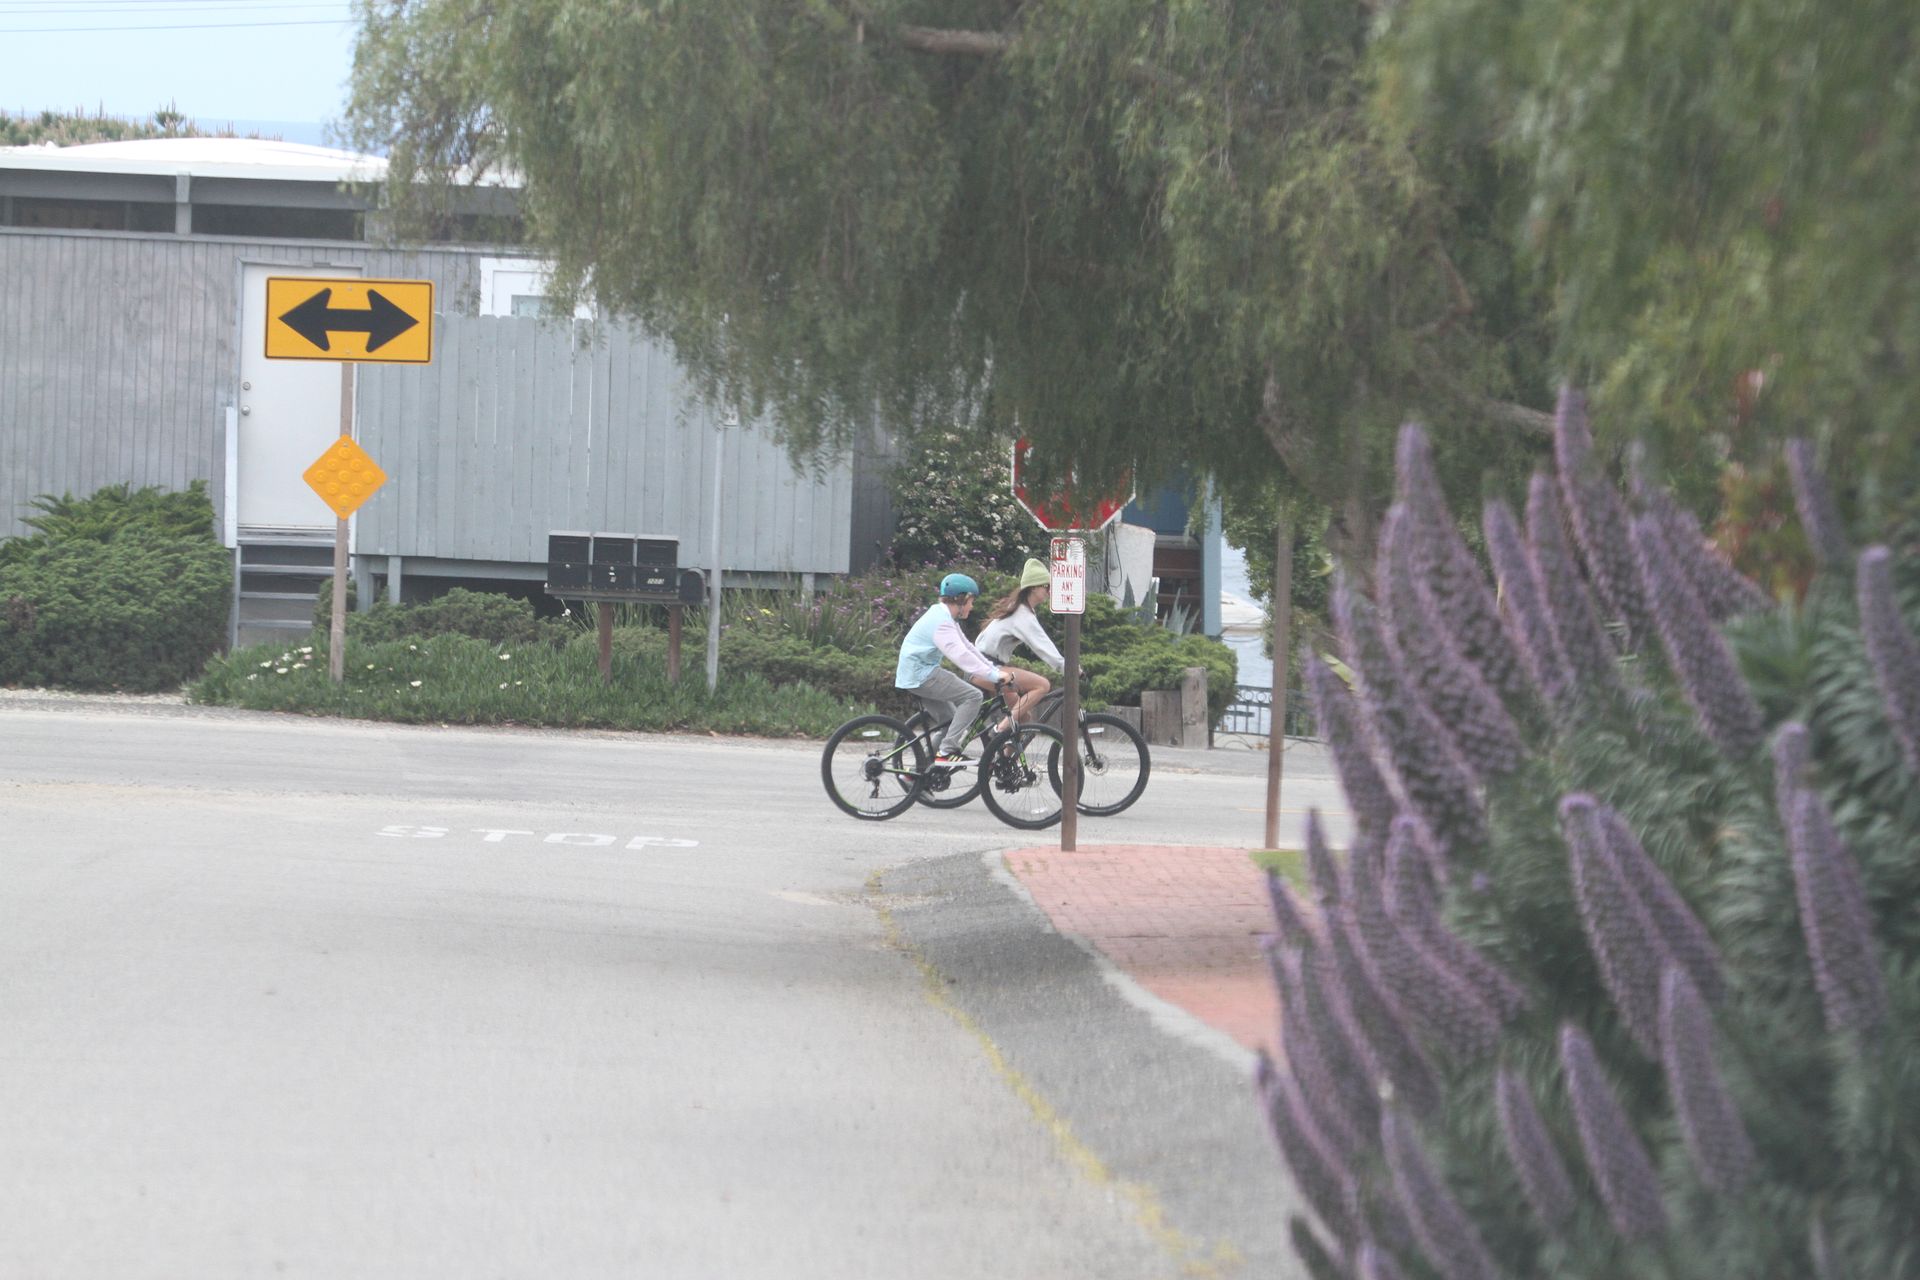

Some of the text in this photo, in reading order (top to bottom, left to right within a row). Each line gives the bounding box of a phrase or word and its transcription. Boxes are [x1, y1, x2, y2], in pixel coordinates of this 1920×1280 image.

[1052, 564, 1083, 578] PARKING
[1061, 581, 1073, 592] ANY
[1061, 594, 1074, 605] TIME
[374, 825, 700, 850] STOP
